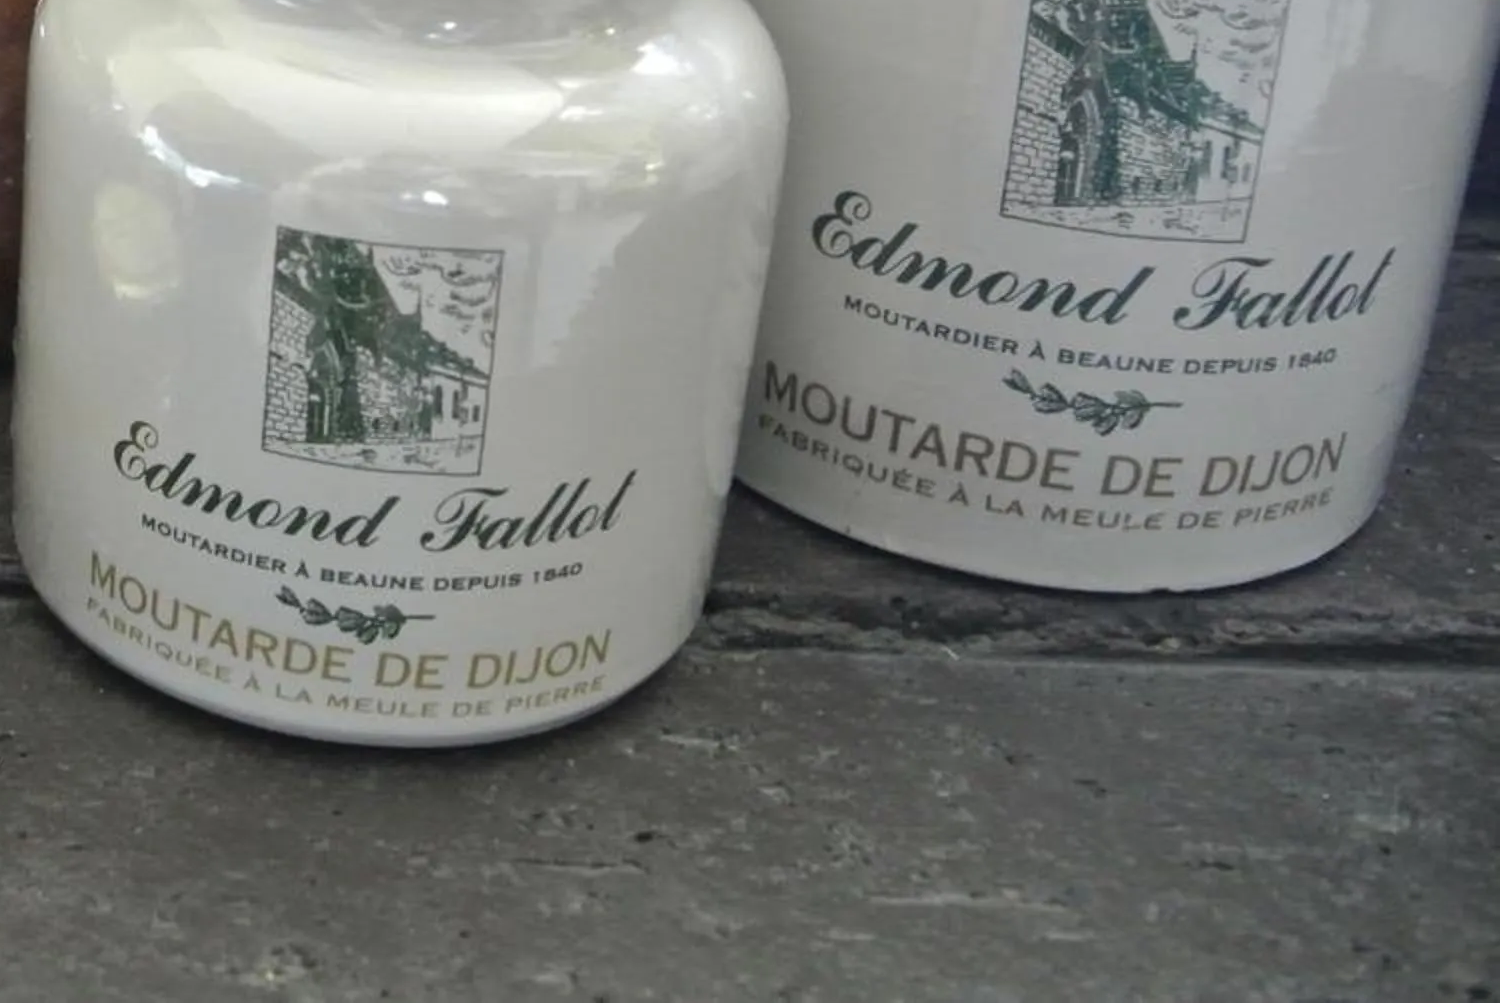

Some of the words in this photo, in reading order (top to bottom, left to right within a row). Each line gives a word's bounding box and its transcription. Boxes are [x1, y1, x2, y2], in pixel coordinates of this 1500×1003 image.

[811, 190, 1156, 327] Edmond
[1172, 247, 1396, 331] Fallot
[844, 294, 1019, 356] MOUTARDIER
[1028, 339, 1046, 361] À
[1057, 348, 1175, 374] BEAUNE
[1183, 356, 1278, 376] DEPUIS
[1287, 347, 1338, 370] 1840
[113, 421, 401, 548] Edmond
[420, 469, 638, 553] Fallot
[758, 412, 937, 498] FABRIQUÉE
[949, 482, 969, 507] À
[985, 493, 1025, 517] LA
[1040, 504, 1164, 531] MEULE
[1176, 509, 1223, 530] DE
[1233, 485, 1334, 528] PIERRE
[764, 359, 1081, 492] MOUTARDE
[1100, 454, 1184, 499] DE
[1198, 430, 1348, 498] DIJON
[141, 513, 287, 574] MOUTARDIER
[295, 559, 310, 579] À
[320, 568, 425, 592] BEAUNE
[433, 573, 523, 592] DEPUIS
[532, 562, 584, 585] 1840
[86, 596, 231, 684] FABRIQUÉE
[243, 674, 261, 692] À
[276, 683, 313, 705] LA
[326, 697, 439, 718] MEULE
[452, 700, 493, 718] DE
[505, 674, 607, 713] PIERRE
[90, 549, 355, 683] MOUTARDE
[374, 652, 450, 690] DE
[466, 628, 612, 690] DIJON
